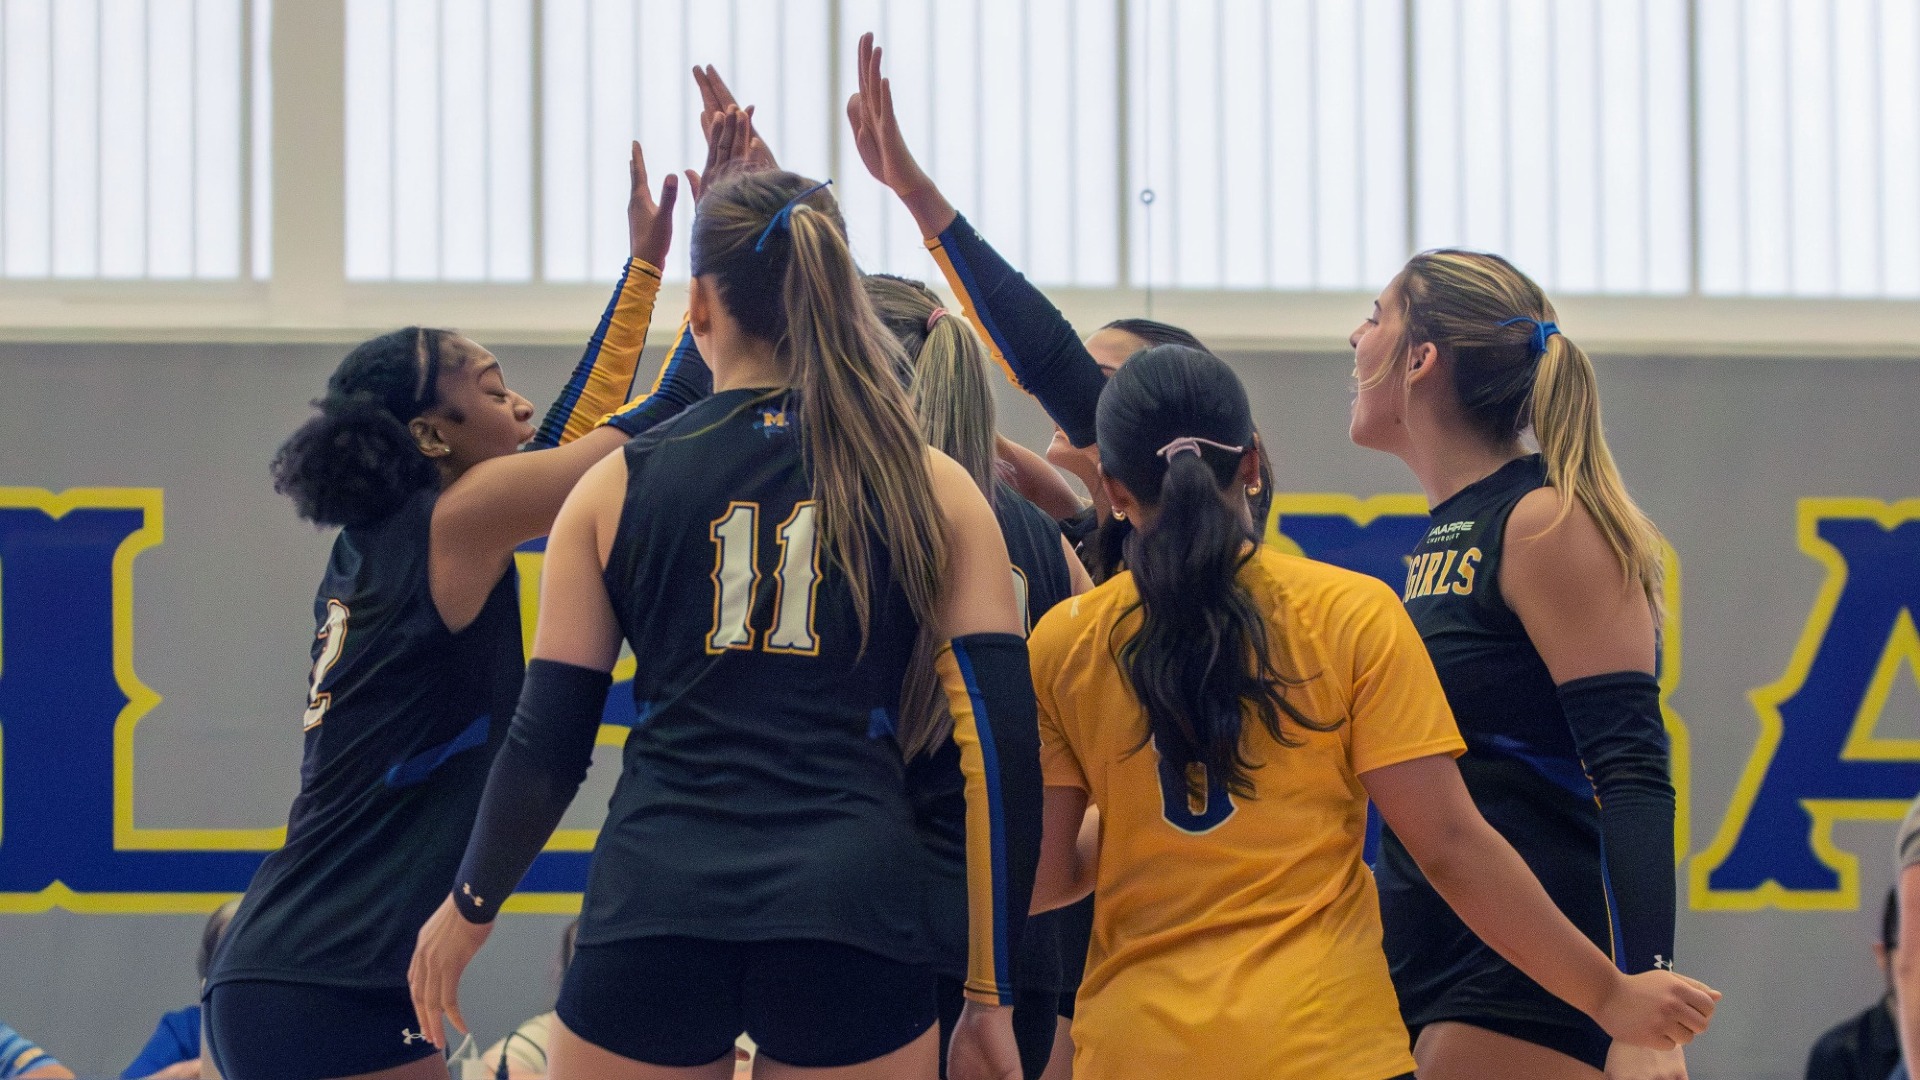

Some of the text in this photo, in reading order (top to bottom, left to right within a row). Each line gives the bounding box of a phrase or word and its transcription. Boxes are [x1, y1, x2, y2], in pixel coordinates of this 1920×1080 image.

[763, 412, 785, 427] M
[705, 500, 823, 656] 11
[1403, 547, 1482, 603] GIRLS
